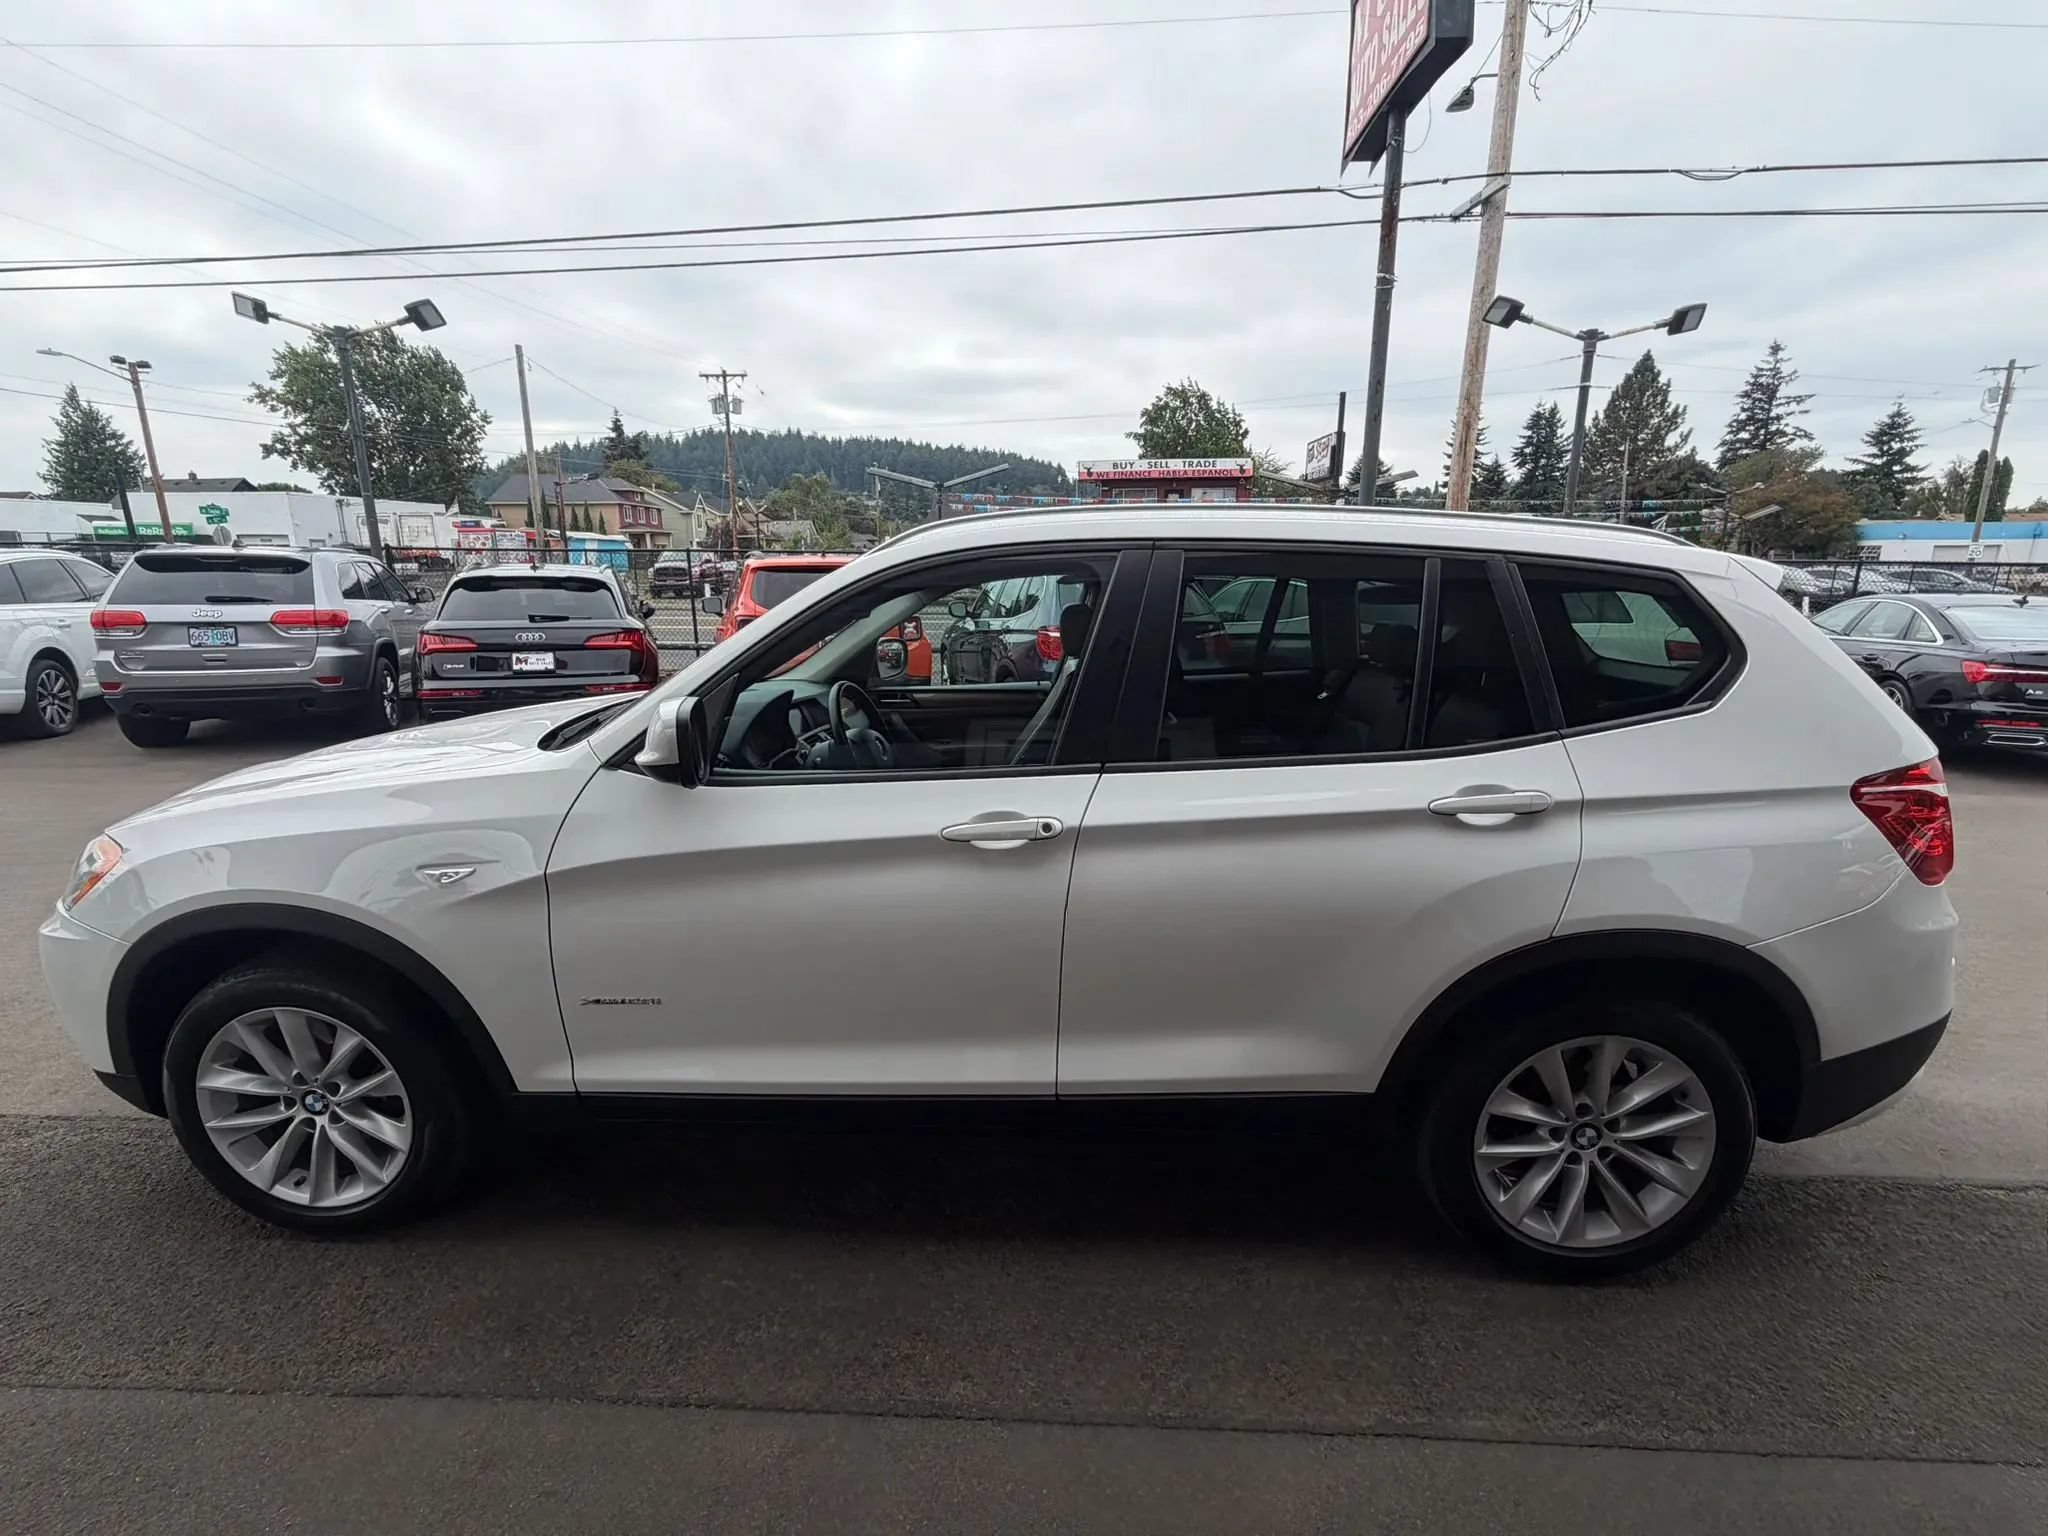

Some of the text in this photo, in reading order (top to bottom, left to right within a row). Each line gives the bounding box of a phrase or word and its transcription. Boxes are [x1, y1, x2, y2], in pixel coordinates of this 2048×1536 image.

[1350, 31, 1378, 113] AUTO
[1112, 462, 1135, 470] BUY
[1147, 461, 1170, 469] SELL
[1182, 460, 1217, 468] TRADE
[1096, 471, 1111, 479] WE
[1113, 470, 1152, 478] FINANCE
[1968, 549, 1982, 557] 20
[192, 608, 223, 619] Jeep
[191, 631, 210, 642] 665
